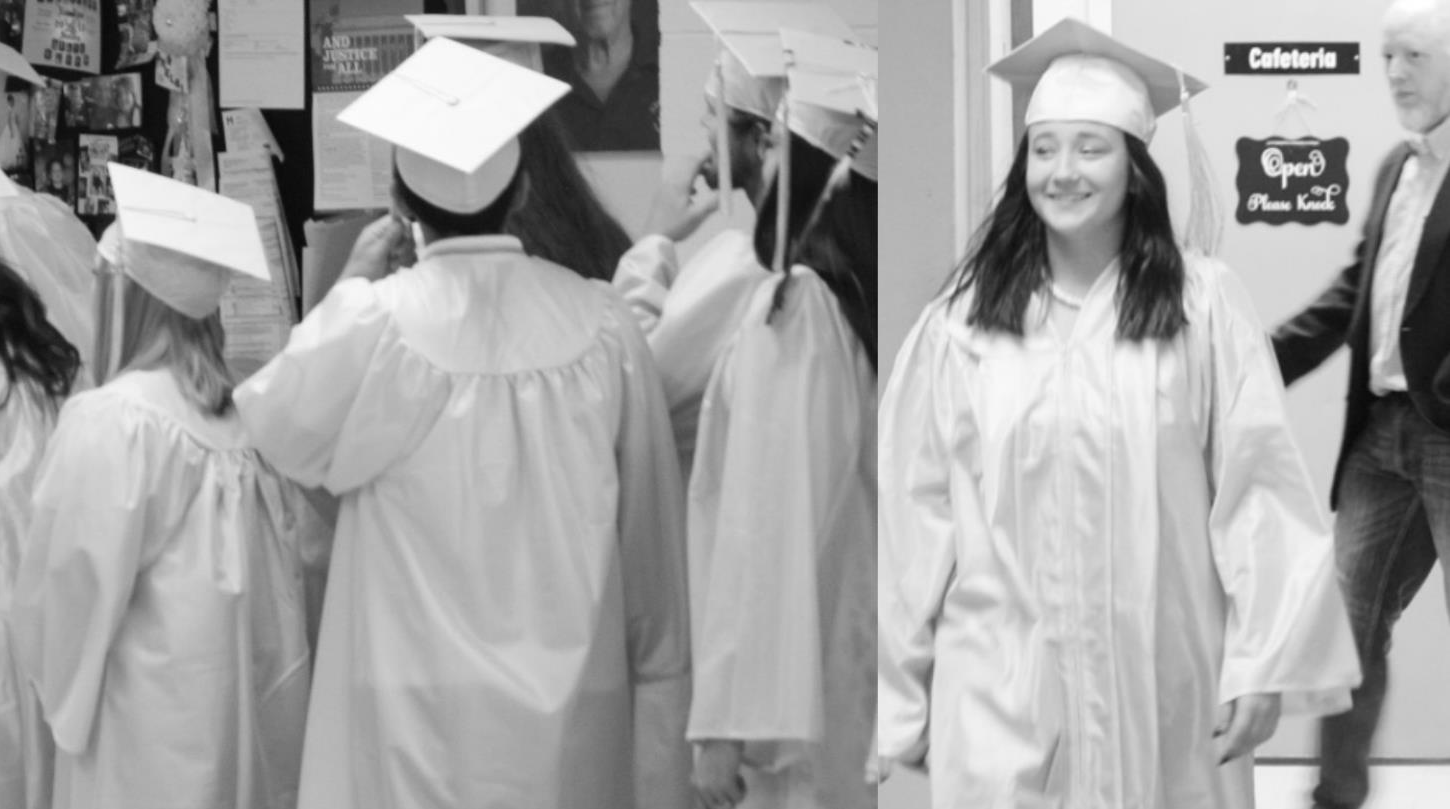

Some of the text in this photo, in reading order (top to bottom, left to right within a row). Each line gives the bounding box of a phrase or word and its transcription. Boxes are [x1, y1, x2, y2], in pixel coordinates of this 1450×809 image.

[323, 35, 351, 49] AND
[323, 47, 378, 62] JUSTICE
[1249, 46, 1337, 70] Cafeteria
[338, 61, 363, 74] ALL
[1260, 146, 1326, 190] Open
[1247, 183, 1341, 212] Please Knock
